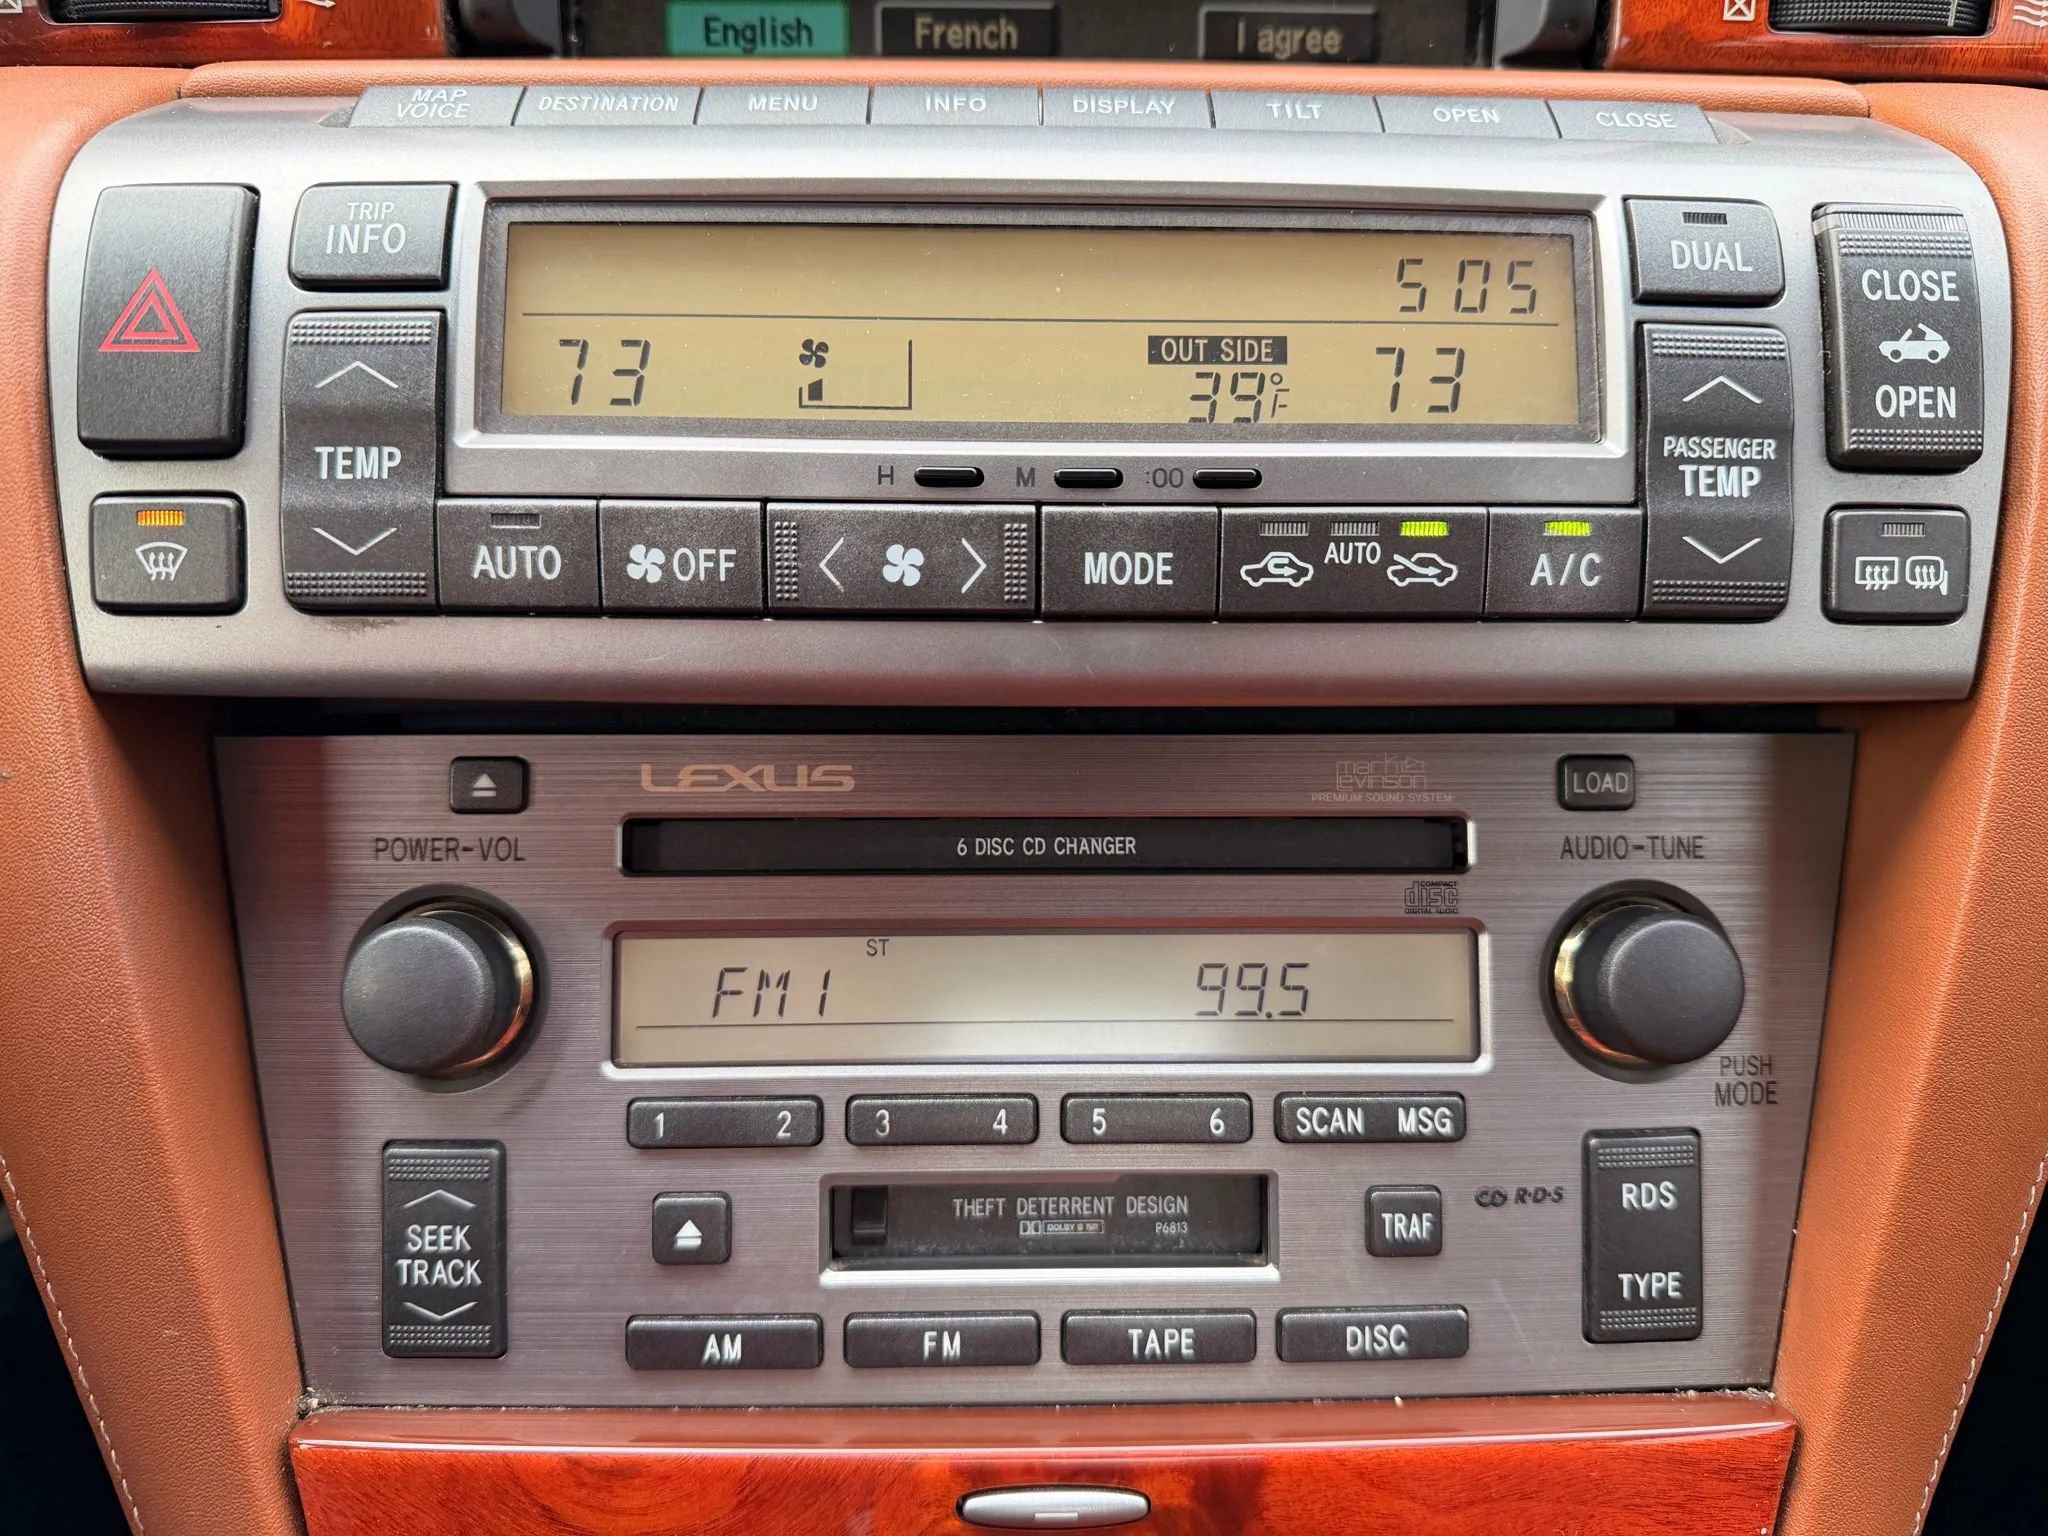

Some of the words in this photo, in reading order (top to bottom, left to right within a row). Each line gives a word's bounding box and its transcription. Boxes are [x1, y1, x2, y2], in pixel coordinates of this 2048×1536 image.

[704, 10, 814, 53] English
[915, 11, 1018, 51] French
[1258, 24, 1343, 59] agree
[411, 87, 467, 103] MAP
[538, 96, 679, 112] DESTINATION
[748, 96, 818, 113] MENU
[925, 96, 986, 114] INFO
[1073, 97, 1176, 115] DISPLAY
[395, 102, 470, 119] VOICE
[1266, 103, 1322, 120] TILT
[1433, 107, 1500, 126] OPEN
[1595, 111, 1678, 130] CLOSE
[348, 201, 394, 220] TRIP
[326, 222, 406, 254] INFO
[1671, 240, 1754, 273] DUAL
[1862, 268, 1959, 301] CLOSE
[1161, 338, 1208, 362] OUT
[1220, 338, 1274, 362] SIDE
[558, 338, 651, 406] 73
[1375, 346, 1466, 414] 73
[1875, 385, 1957, 418] OPEN
[1663, 436, 1776, 461] PASSENGER
[315, 445, 402, 481] TEMP
[878, 466, 894, 486] H
[1016, 466, 1036, 487] M
[1145, 466, 1184, 488] :00
[1679, 465, 1761, 498] TEMP
[472, 545, 563, 581] AUTO
[673, 547, 737, 582] OFF
[1324, 541, 1381, 566] AUTO
[1084, 551, 1174, 585] MODE
[1530, 553, 1601, 587] A/C
[641, 763, 855, 792] LEXUS
[1573, 771, 1630, 795] LOAD
[1312, 792, 1361, 802] PREMIUM
[1365, 792, 1403, 802] SOUND
[374, 836, 527, 863] POWER-VOL
[957, 837, 968, 856] 6
[975, 837, 1015, 856] DISC
[1022, 837, 1046, 855] CD
[1054, 836, 1137, 855] CHANGER
[1560, 836, 1706, 860] AUDIO-TUNE
[865, 938, 889, 956] ST
[1194, 962, 1310, 1019] 99.5
[1719, 1056, 1773, 1076] PUSH
[1714, 1080, 1778, 1107] MODE
[655, 1112, 665, 1138] 1
[776, 1110, 792, 1138] 2
[875, 1110, 890, 1137] 3
[992, 1108, 1008, 1135] 4
[1092, 1108, 1107, 1135] 5
[1209, 1108, 1225, 1135] 6
[1297, 1108, 1364, 1136] SCAN
[1398, 1108, 1453, 1136] MSG
[953, 1198, 1006, 1217] THEFT
[1017, 1196, 1115, 1216] DETERRENT
[1126, 1195, 1188, 1215] DESIGN
[1622, 1183, 1677, 1211] RDS
[407, 1224, 472, 1253] SEEK
[1047, 1223, 1074, 1231] DOLBY
[1155, 1222, 1188, 1234] P6813
[1382, 1213, 1432, 1242] TRAF
[396, 1259, 482, 1287] TRACK
[1618, 1272, 1683, 1300] TYPE
[702, 1334, 742, 1365] AM
[923, 1331, 961, 1362] FM
[1128, 1328, 1195, 1361] TAPE
[1346, 1325, 1407, 1356] DISC
